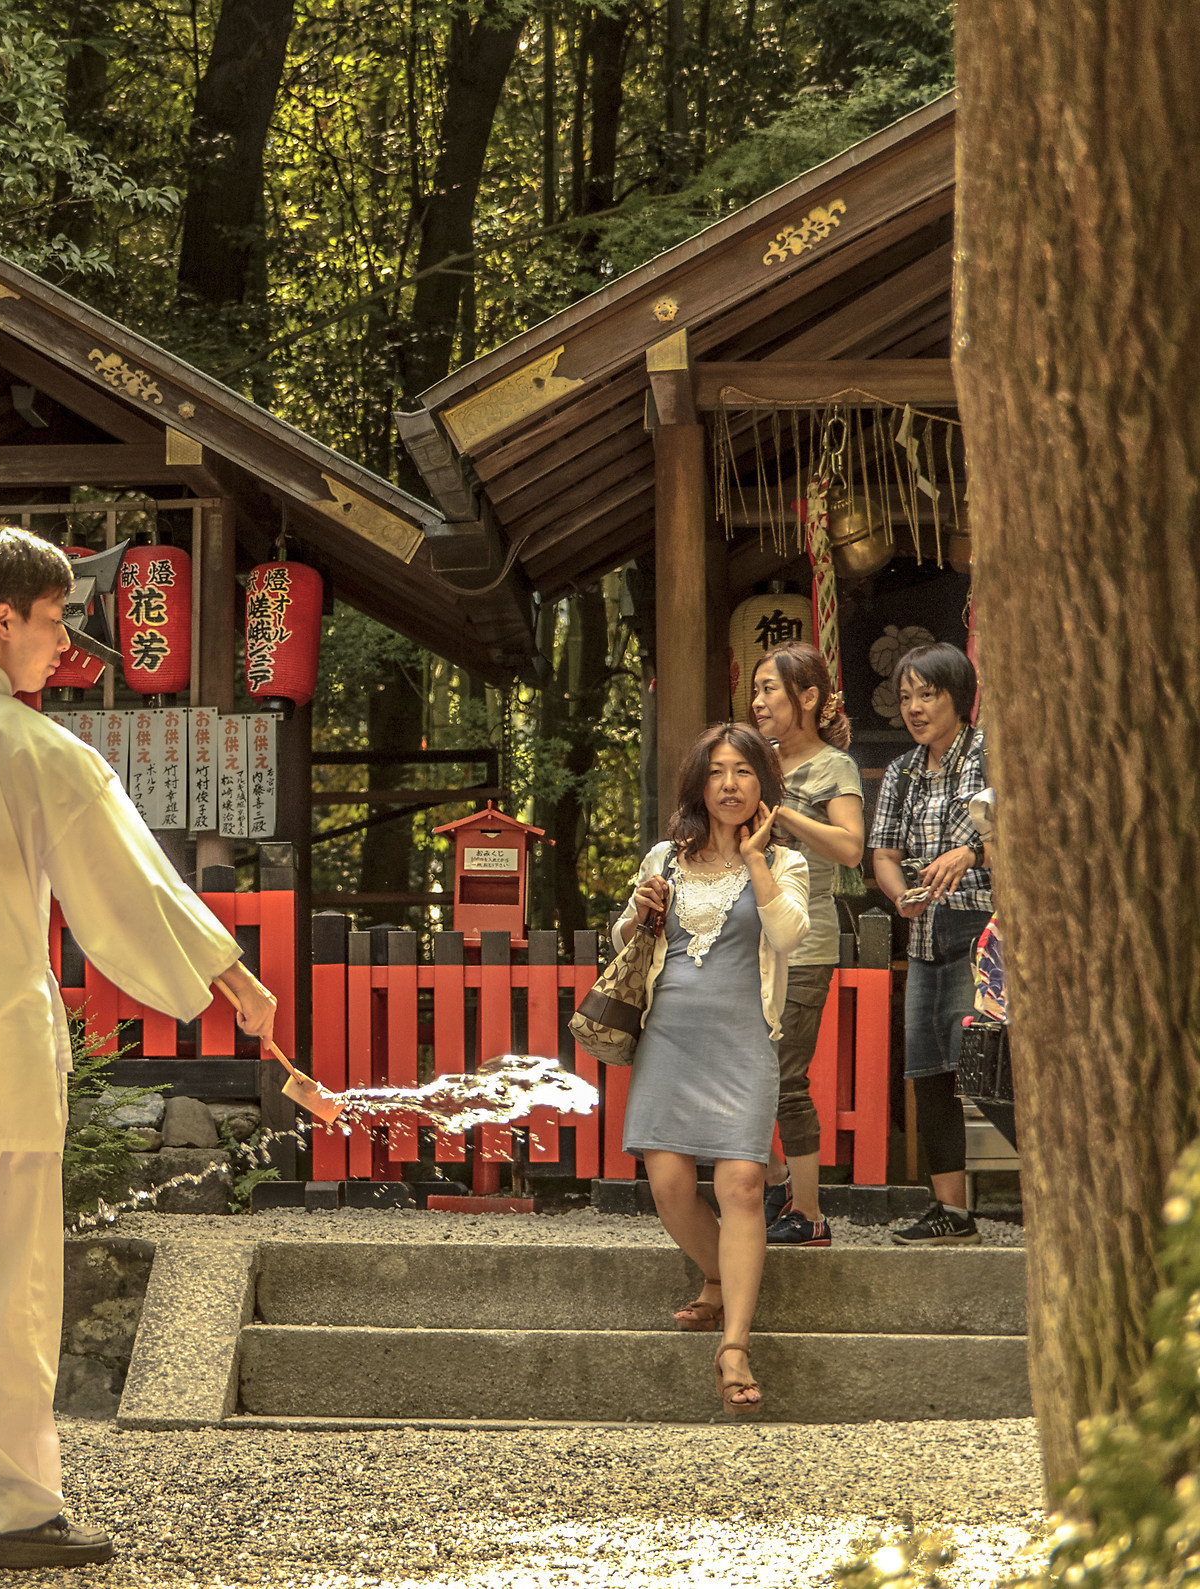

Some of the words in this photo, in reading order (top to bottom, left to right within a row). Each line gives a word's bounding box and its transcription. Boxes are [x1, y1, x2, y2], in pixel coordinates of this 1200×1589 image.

[126, 586, 171, 673] 花芳
[754, 609, 803, 652] 御
[106, 713, 122, 764] お供え
[136, 712, 152, 764] お供え
[163, 711, 179, 763] お供え
[194, 710, 210, 763] お供え
[223, 718, 240, 770] お供え
[253, 716, 269, 770] お供え
[476, 850, 505, 858] おみくじ
